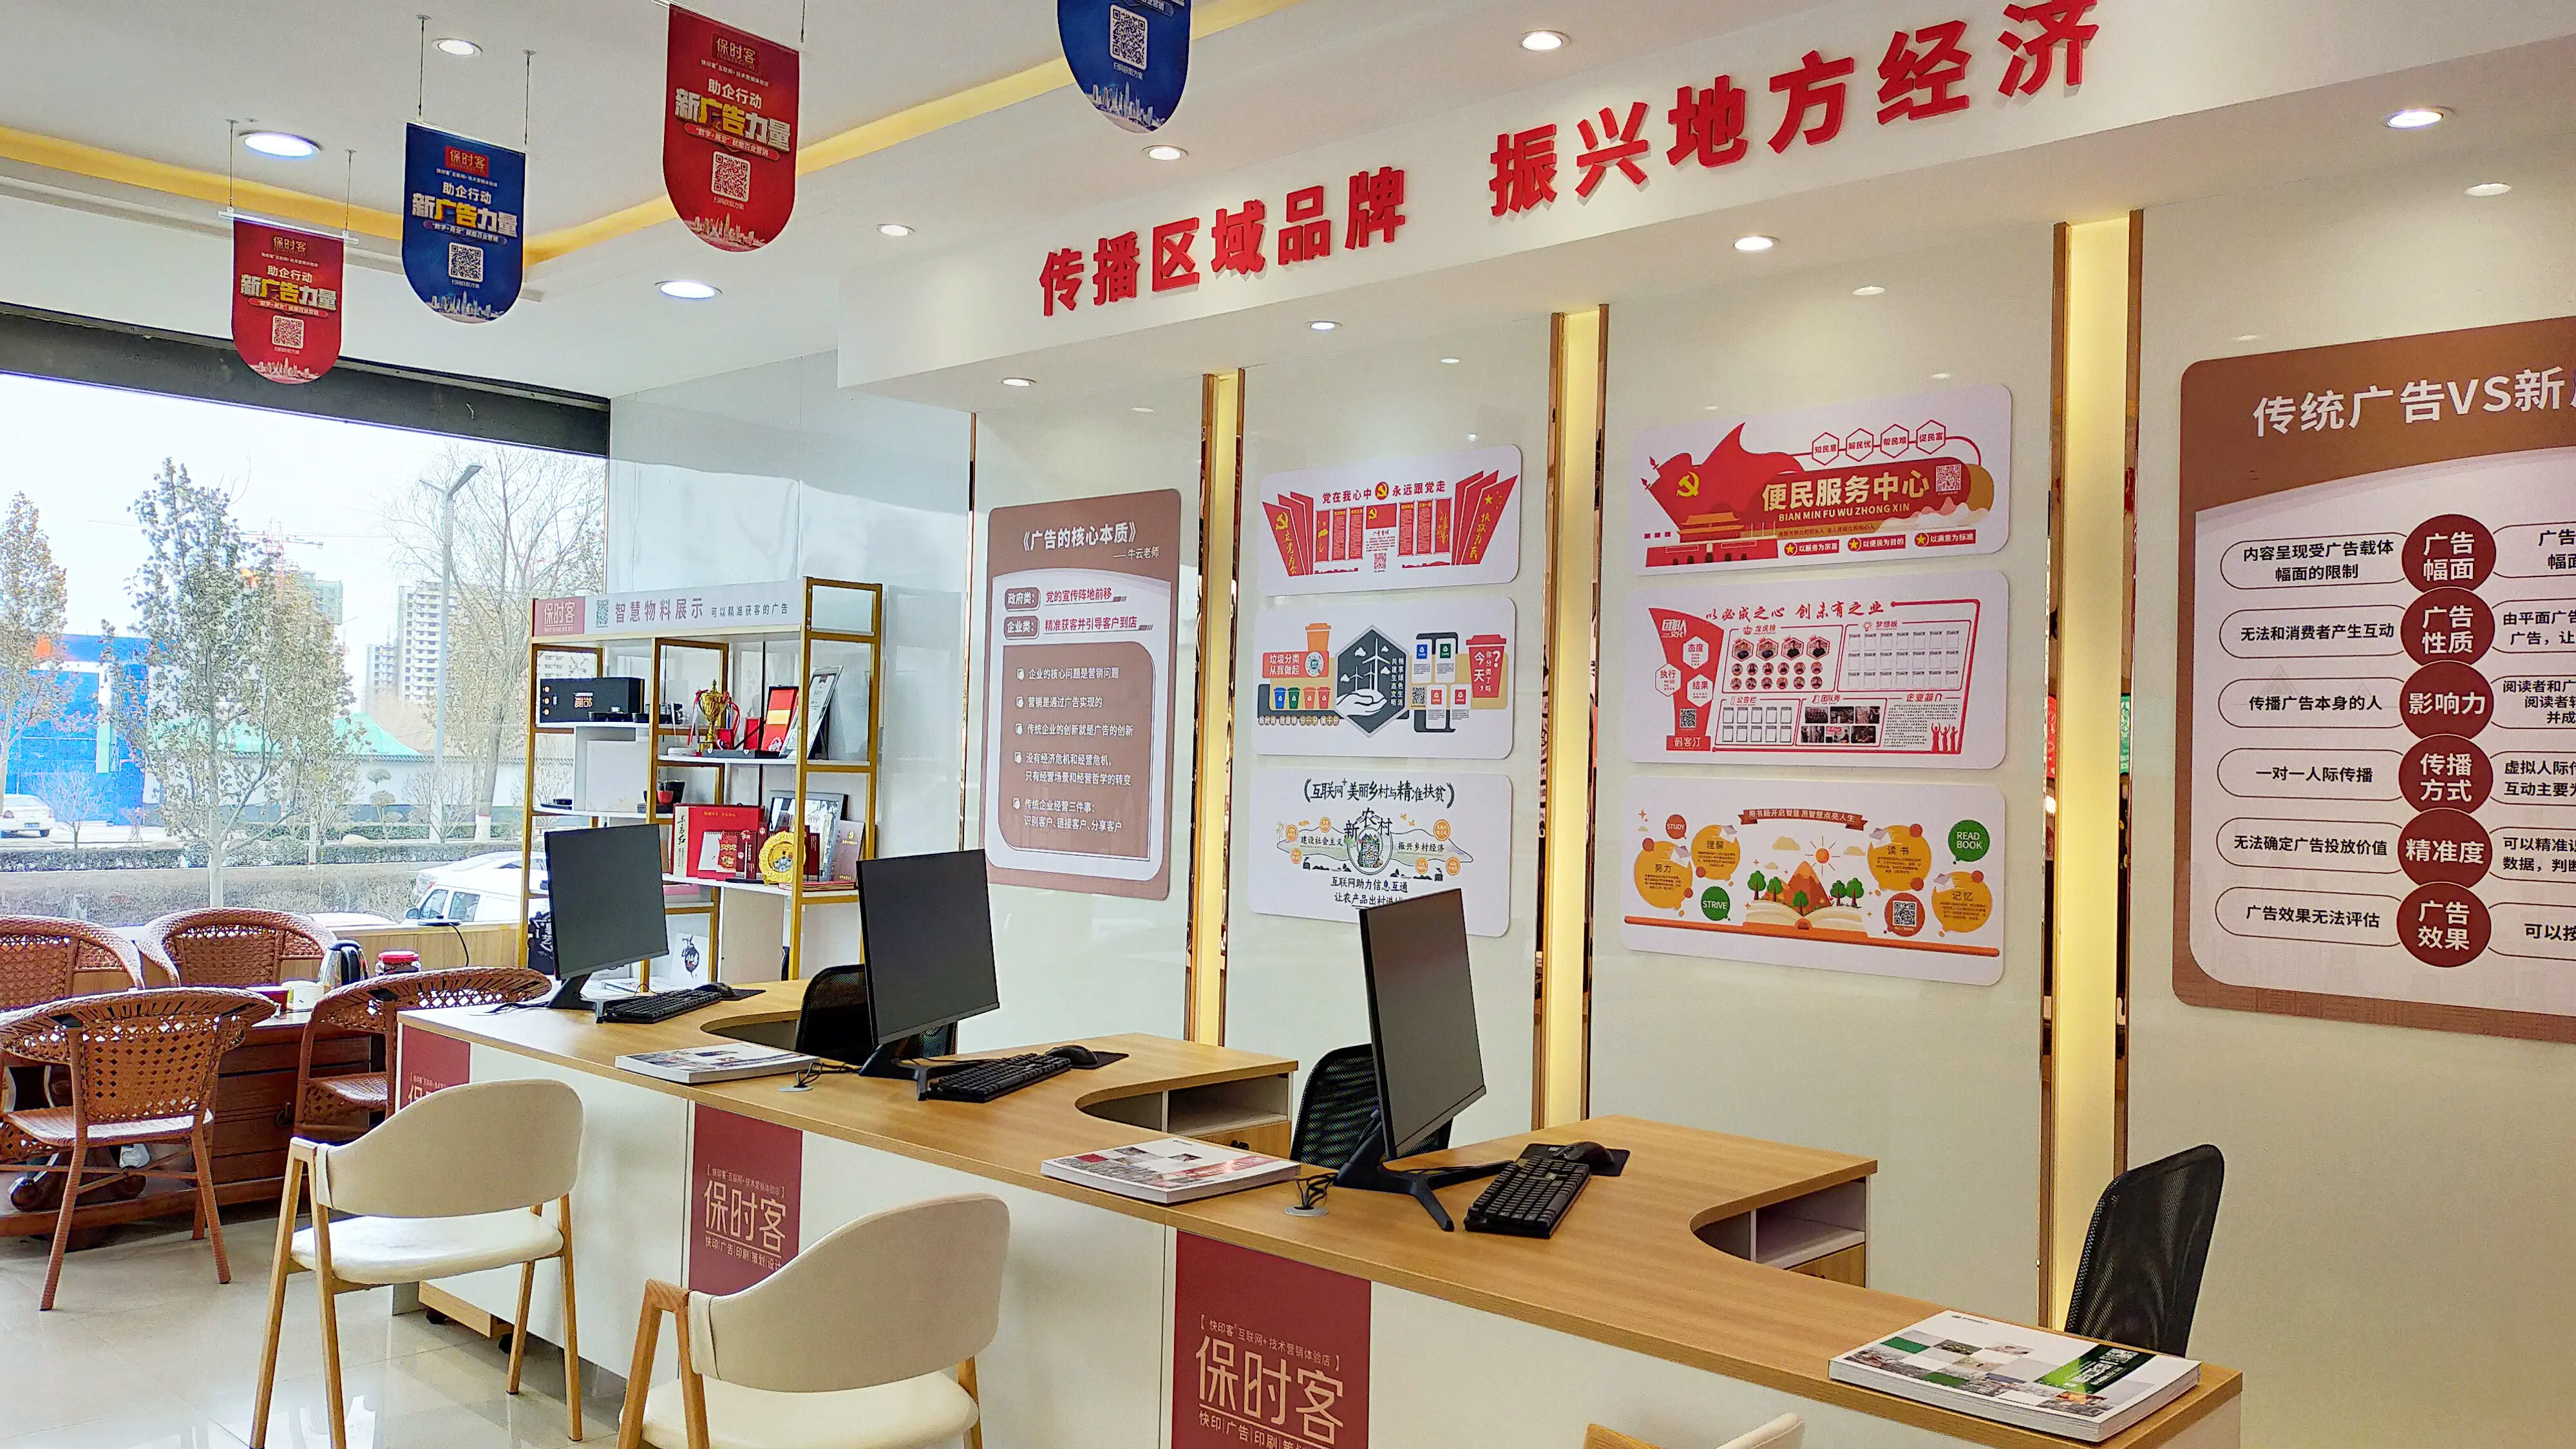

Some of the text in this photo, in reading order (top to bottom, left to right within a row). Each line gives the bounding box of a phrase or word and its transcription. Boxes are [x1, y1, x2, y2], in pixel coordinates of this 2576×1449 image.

[716, 37, 755, 64] 保时客
[708, 78, 762, 109] 助企行动
[675, 88, 791, 153] 新广告力量
[450, 149, 486, 169] 保时客
[1039, 0, 2099, 317] 传播区域品牌 振兴地方经济
[442, 181, 491, 205] 助企行动
[412, 193, 518, 238] 新广告力量
[273, 236, 307, 252] 保时客
[267, 265, 313, 283] 助企行动
[240, 274, 337, 311] 新广告力量
[2252, 365, 2576, 438] 传统广告VS新
[1848, 440, 1871, 450] 解民忧
[1883, 436, 1907, 447] 帮民难
[1919, 431, 1944, 442] 促民富
[1814, 444, 1837, 454] 知民意
[1322, 480, 1446, 504] 党在我心中 永远跟党走
[1762, 469, 1929, 512] 便民服务中心
[1779, 502, 1910, 522] BIAN MIN FU WU ZHONG XIN
[1023, 521, 1137, 551] 《广告的核心本质》
[1862, 537, 1904, 548] 以便民为目的
[1930, 533, 1974, 543] 以满意为标准
[2422, 531, 2476, 558] 广告
[1799, 542, 1838, 552] 以服务为宗旨
[2243, 539, 2394, 562] 内容呈现受广告载体
[2275, 564, 2359, 582] 幅面的限制
[2422, 557, 2475, 582] 幅面
[1046, 587, 1112, 603] 党的宣传阵地前移
[544, 601, 575, 625] 保时客
[615, 597, 789, 625] 智慧物料展示 可以精准获客的广告
[1706, 600, 1884, 622] 以必成之心 创未有之业
[2422, 605, 2474, 629] 广告
[1045, 616, 1138, 632] 精准获客并引导客户到店
[1661, 619, 1687, 632] 团队
[2240, 622, 2395, 642] 无法和消费者产生互动
[1687, 643, 1704, 652] 态度
[2421, 630, 2474, 656] 性质
[1269, 654, 1300, 664] 垃圾分类
[1028, 667, 1119, 680] 企业的核心问题是营销问题
[1269, 664, 1300, 676] 从我做起
[1660, 669, 1676, 679] 执行
[1692, 680, 1709, 690] 结果
[1028, 696, 1103, 709] 营销是通过广告实现的
[1906, 693, 1942, 702] 企业简介
[2248, 694, 2383, 712] 传播广告本身的人
[2407, 691, 2486, 716] 影响力
[1027, 724, 1133, 737] 传统企业的创新就是广告的创新
[2255, 765, 2374, 783] 一对一人际传播
[2419, 753, 2473, 777] 传播
[1025, 771, 1132, 786] 只有经营场景和经营哲学的转变
[2419, 778, 2472, 803] 方式
[1024, 816, 1122, 833] 识别客户、链接客户、分享客户
[1343, 807, 1393, 840] 新农村
[1748, 809, 1855, 822] 用书籍开启智慧 用智慧点亮人生
[1300, 836, 1344, 847] 建设社会主义
[1706, 840, 1724, 849] 理解
[1956, 831, 1980, 841] READ
[1956, 840, 1983, 850] BOOK
[1397, 842, 1444, 853] 振兴乡村经济
[1887, 845, 1909, 856] 读书
[2234, 834, 2388, 857] 无法确定广告投放价值
[2405, 838, 2485, 865] 精准度
[1654, 864, 1672, 873] 努力
[1331, 876, 1408, 893] 互联网助力信息互通
[1702, 900, 1727, 910] STRIVE
[1951, 891, 1973, 902] 记忆
[2246, 904, 2381, 929] 广告效果无法评估
[2418, 901, 2471, 925] 广告
[2418, 926, 2470, 951] 效果
[704, 1179, 786, 1253] 保时客
[1196, 1334, 1344, 1445] 保时客
